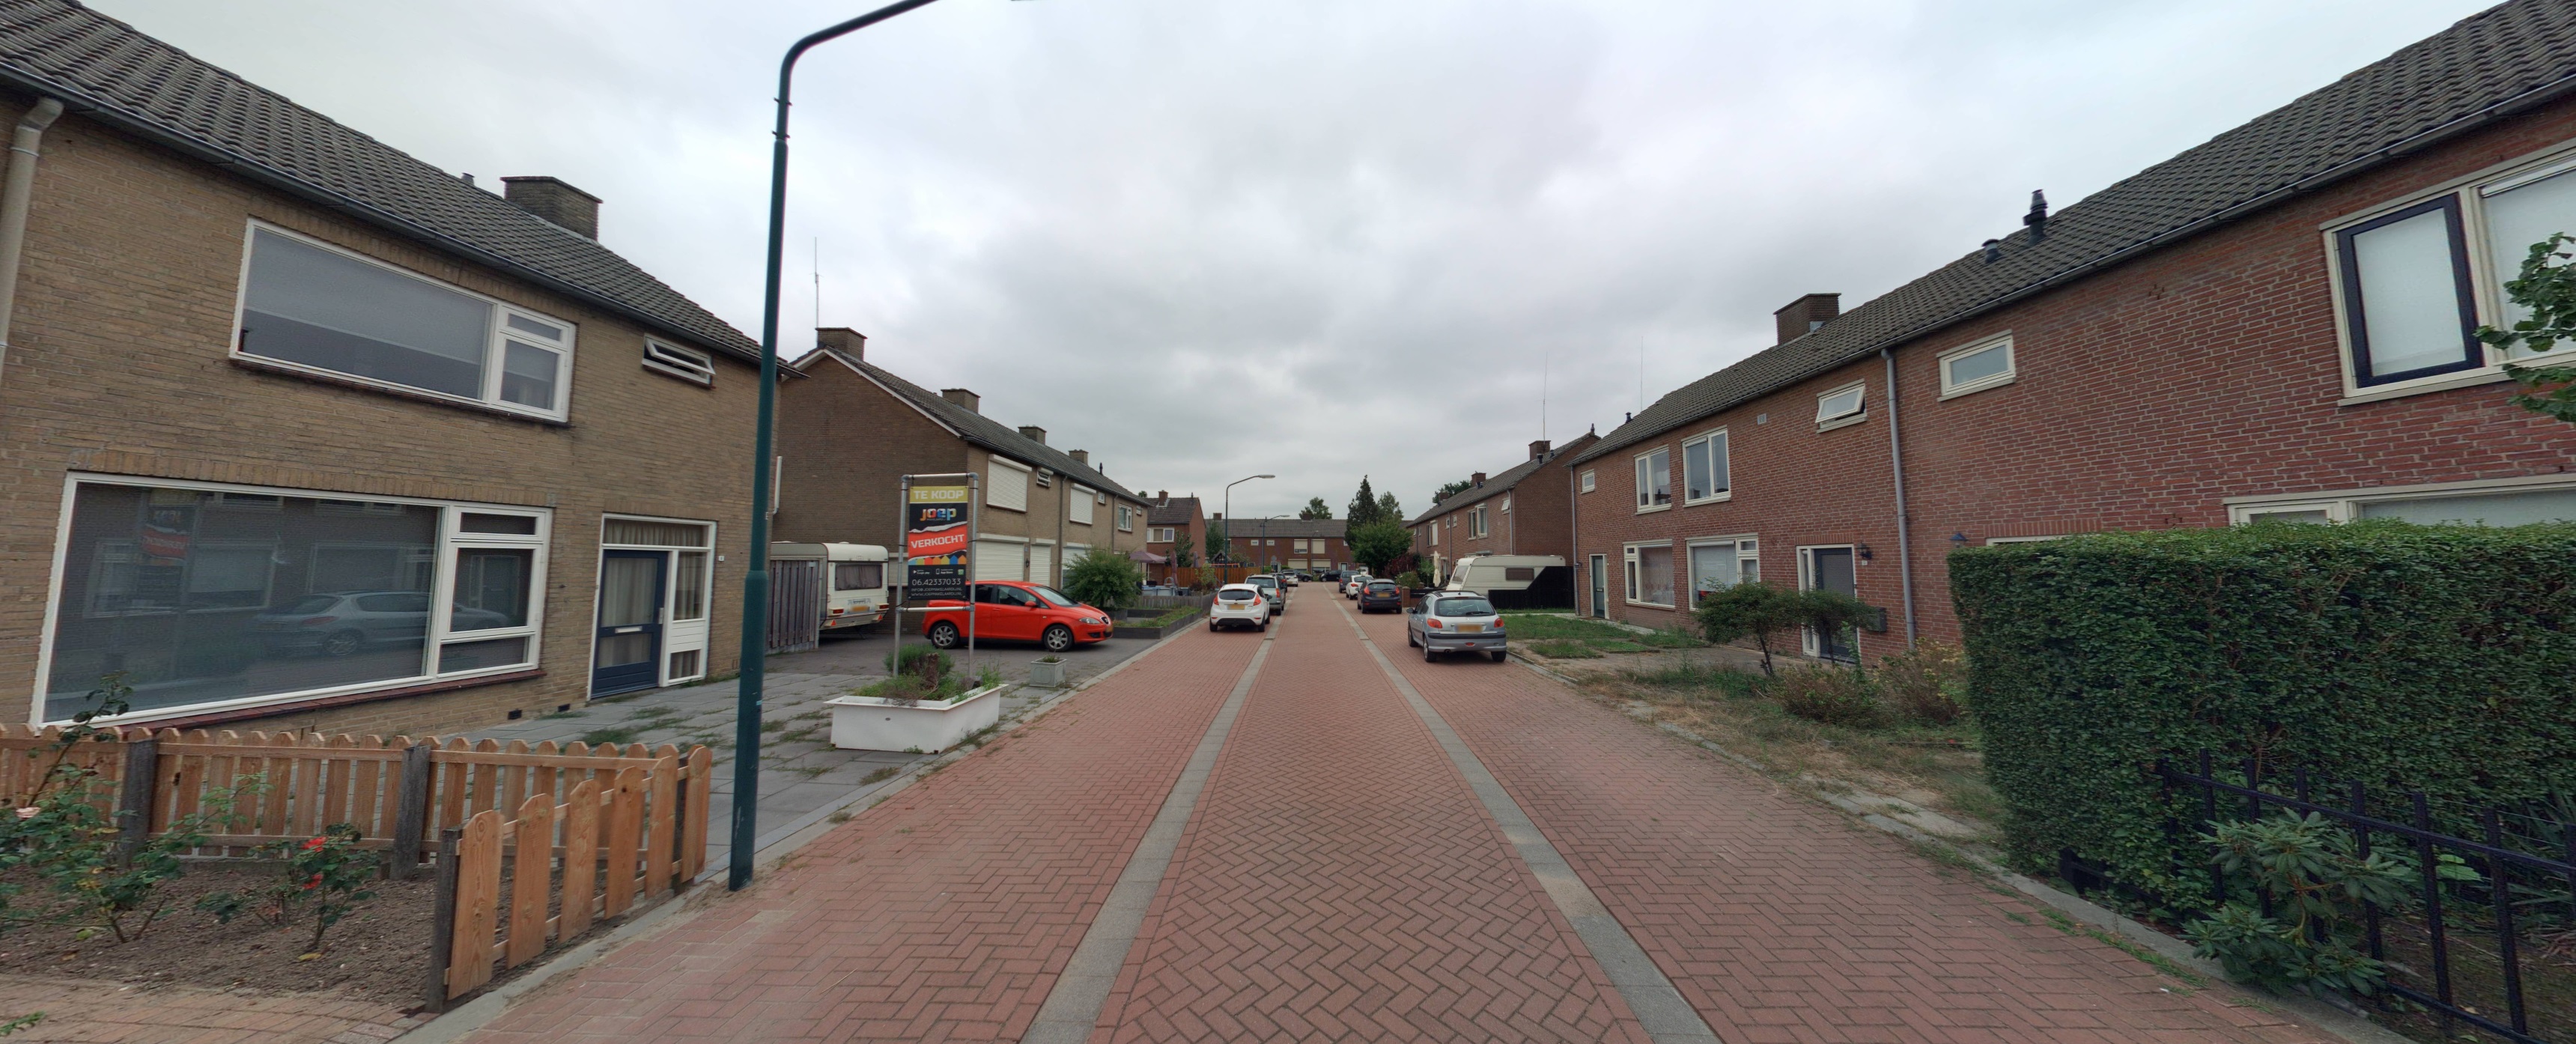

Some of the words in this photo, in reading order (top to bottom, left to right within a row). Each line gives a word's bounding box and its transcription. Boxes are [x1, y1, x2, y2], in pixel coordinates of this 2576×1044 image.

[914, 491, 928, 500] TE
[931, 490, 965, 500] KOOP
[911, 534, 965, 549] VERKOCHT
